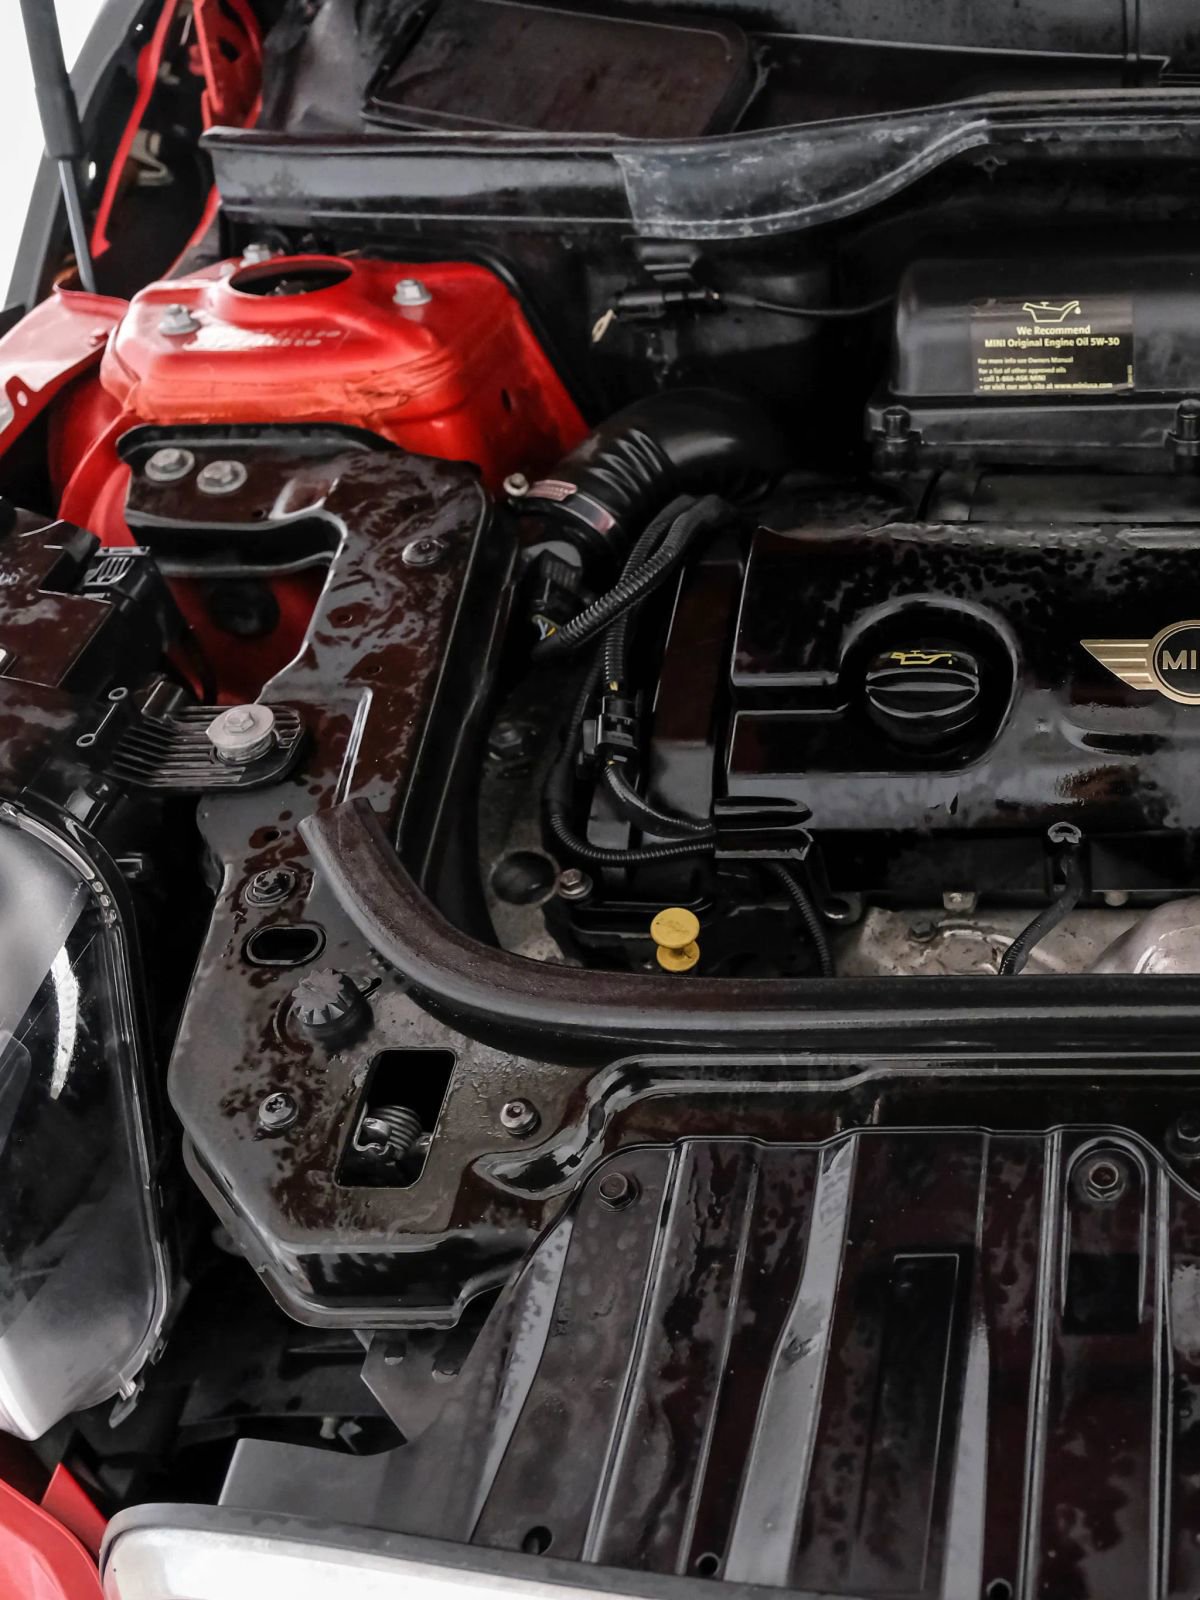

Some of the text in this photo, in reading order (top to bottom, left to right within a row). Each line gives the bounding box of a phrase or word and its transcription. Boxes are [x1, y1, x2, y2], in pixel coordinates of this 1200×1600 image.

[1016, 324, 1090, 335] We Recommend
[985, 337, 1120, 349] MINI Original Engine Oil 5W-30
